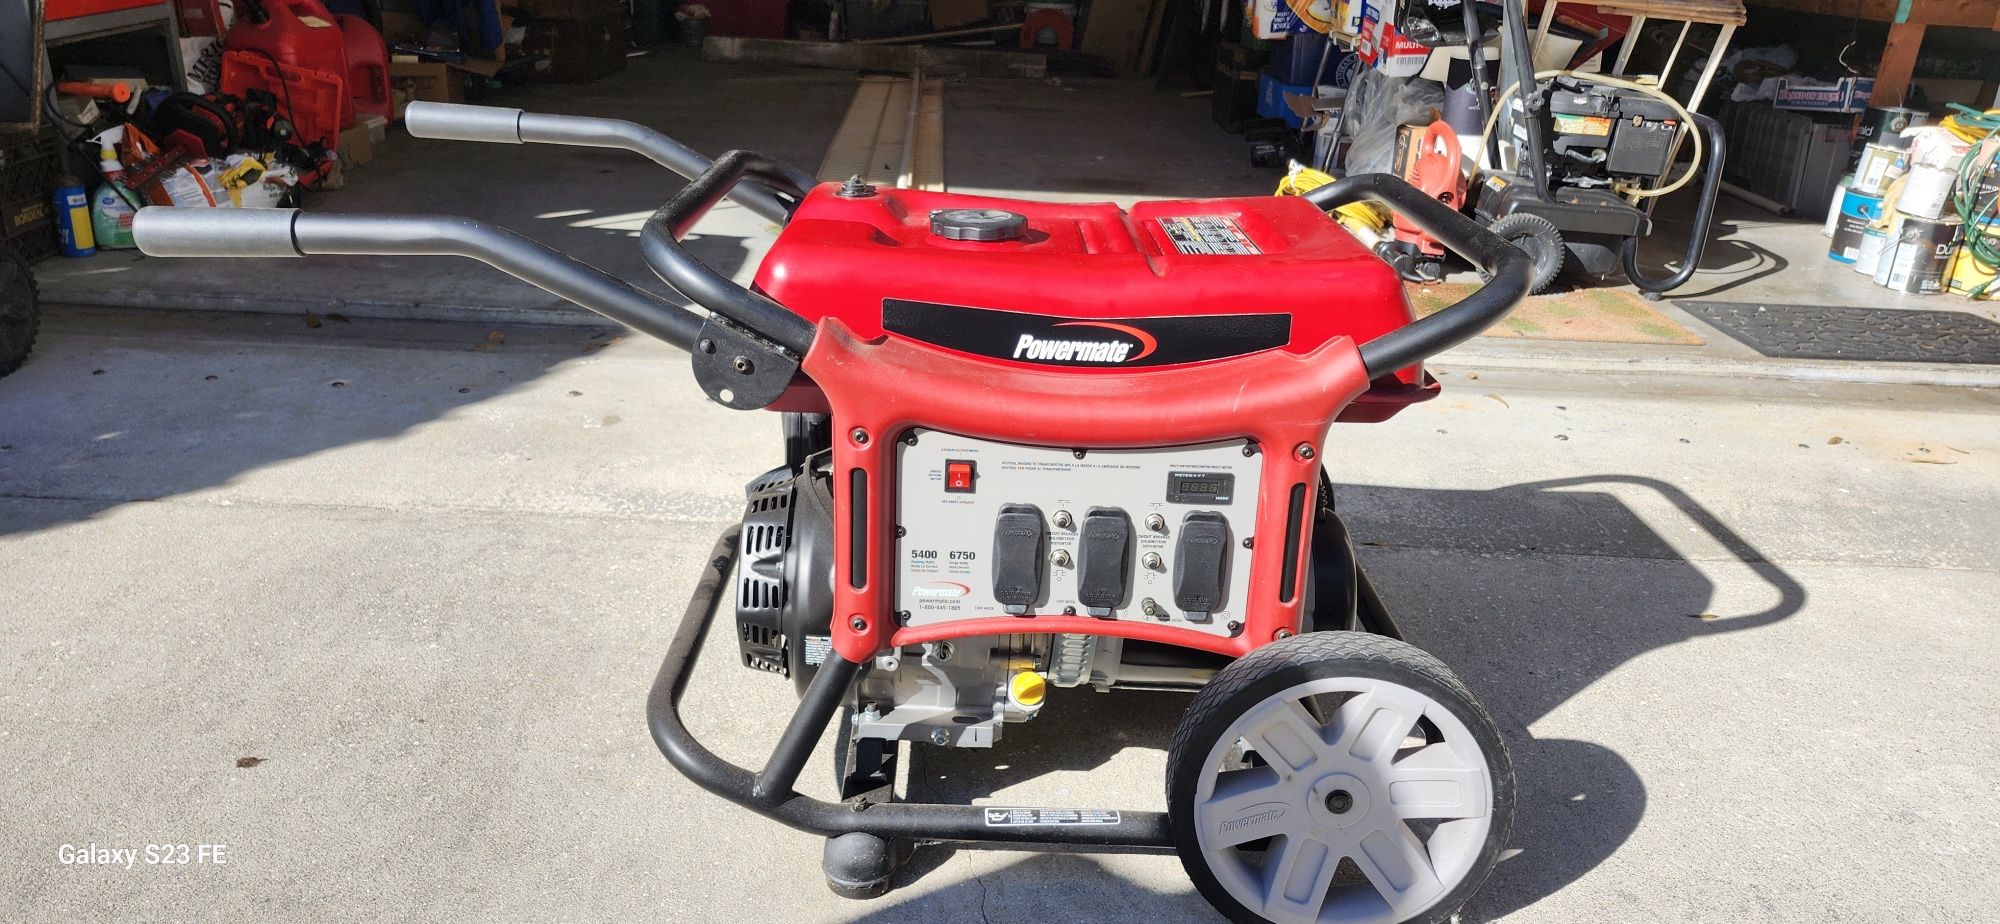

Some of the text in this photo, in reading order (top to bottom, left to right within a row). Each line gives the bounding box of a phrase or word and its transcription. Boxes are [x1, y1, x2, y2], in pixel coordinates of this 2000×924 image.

[1395, 40, 1423, 49] MULTI-
[1013, 333, 1130, 363] Powermate
[911, 549, 938, 559] 5400
[949, 551, 976, 560] 6750
[1218, 808, 1280, 836] Powermate
